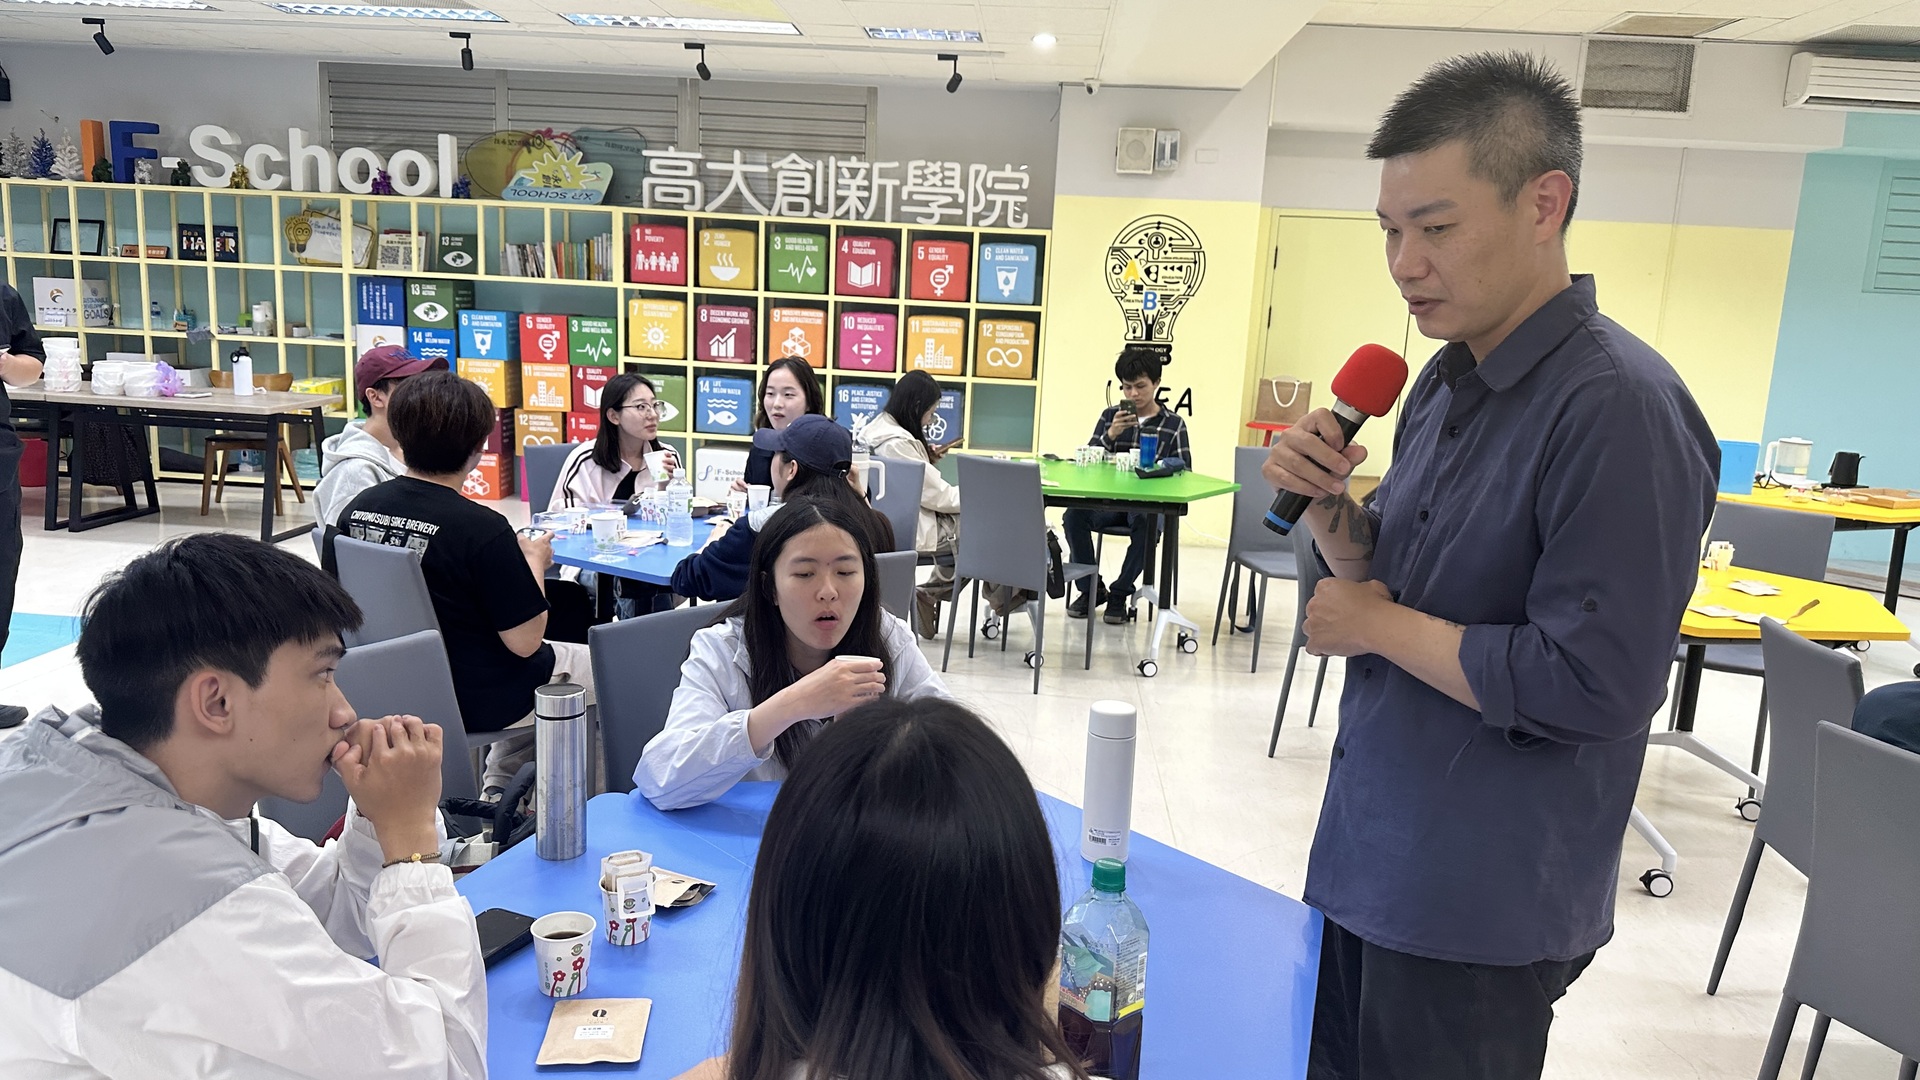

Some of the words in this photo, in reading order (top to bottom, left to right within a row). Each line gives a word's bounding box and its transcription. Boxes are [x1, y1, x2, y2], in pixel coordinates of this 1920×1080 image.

[80, 119, 457, 198] IF-School
[510, 188, 568, 199] SCHOOL
[642, 146, 1030, 229] 高大創新學院
[441, 236, 450, 246] 13
[635, 228, 641, 242] 1
[644, 235, 665, 243] POVERTY
[703, 232, 711, 246] 2
[182, 236, 236, 253] MAER
[774, 236, 782, 250] 3
[841, 239, 849, 254] 4
[852, 240, 871, 248] QUALITY
[852, 247, 876, 255] EDUCATION
[917, 246, 925, 260] 5
[928, 246, 946, 254] GENDER
[985, 247, 992, 261] 6
[995, 247, 1009, 255] CLEAN
[1009, 248, 1024, 256] WATER
[928, 253, 949, 261] EQUALITY
[1124, 260, 1139, 281] A
[410, 283, 421, 295] 13
[1142, 291, 1158, 310] B
[83, 308, 109, 320] GOALS
[633, 302, 639, 316] 7
[700, 308, 708, 323] 8
[710, 309, 726, 317] DECENT
[726, 310, 739, 318] WORK
[739, 311, 749, 319] AND
[461, 314, 469, 326] 6
[526, 316, 533, 329] 5
[710, 316, 731, 324] ECONOMIC
[731, 317, 750, 325] GROWTH
[773, 309, 781, 323] 9
[857, 316, 877, 324] REDUCED
[571, 319, 579, 332] 3
[843, 316, 855, 330] 10
[857, 323, 885, 332] INEQUALITIES
[911, 319, 920, 334] 11
[983, 323, 993, 337] 12
[413, 331, 423, 343] 14
[460, 360, 465, 373] 7
[524, 365, 533, 377] 11
[577, 367, 584, 380] 4
[699, 380, 710, 394] 14
[727, 388, 742, 396] WATER
[838, 389, 850, 403] 16
[866, 390, 883, 398] JUSTICE
[518, 414, 528, 426] 12
[570, 417, 576, 430] 1
[389, 516, 407, 529] SAKE
[405, 518, 440, 536] BREWERY
